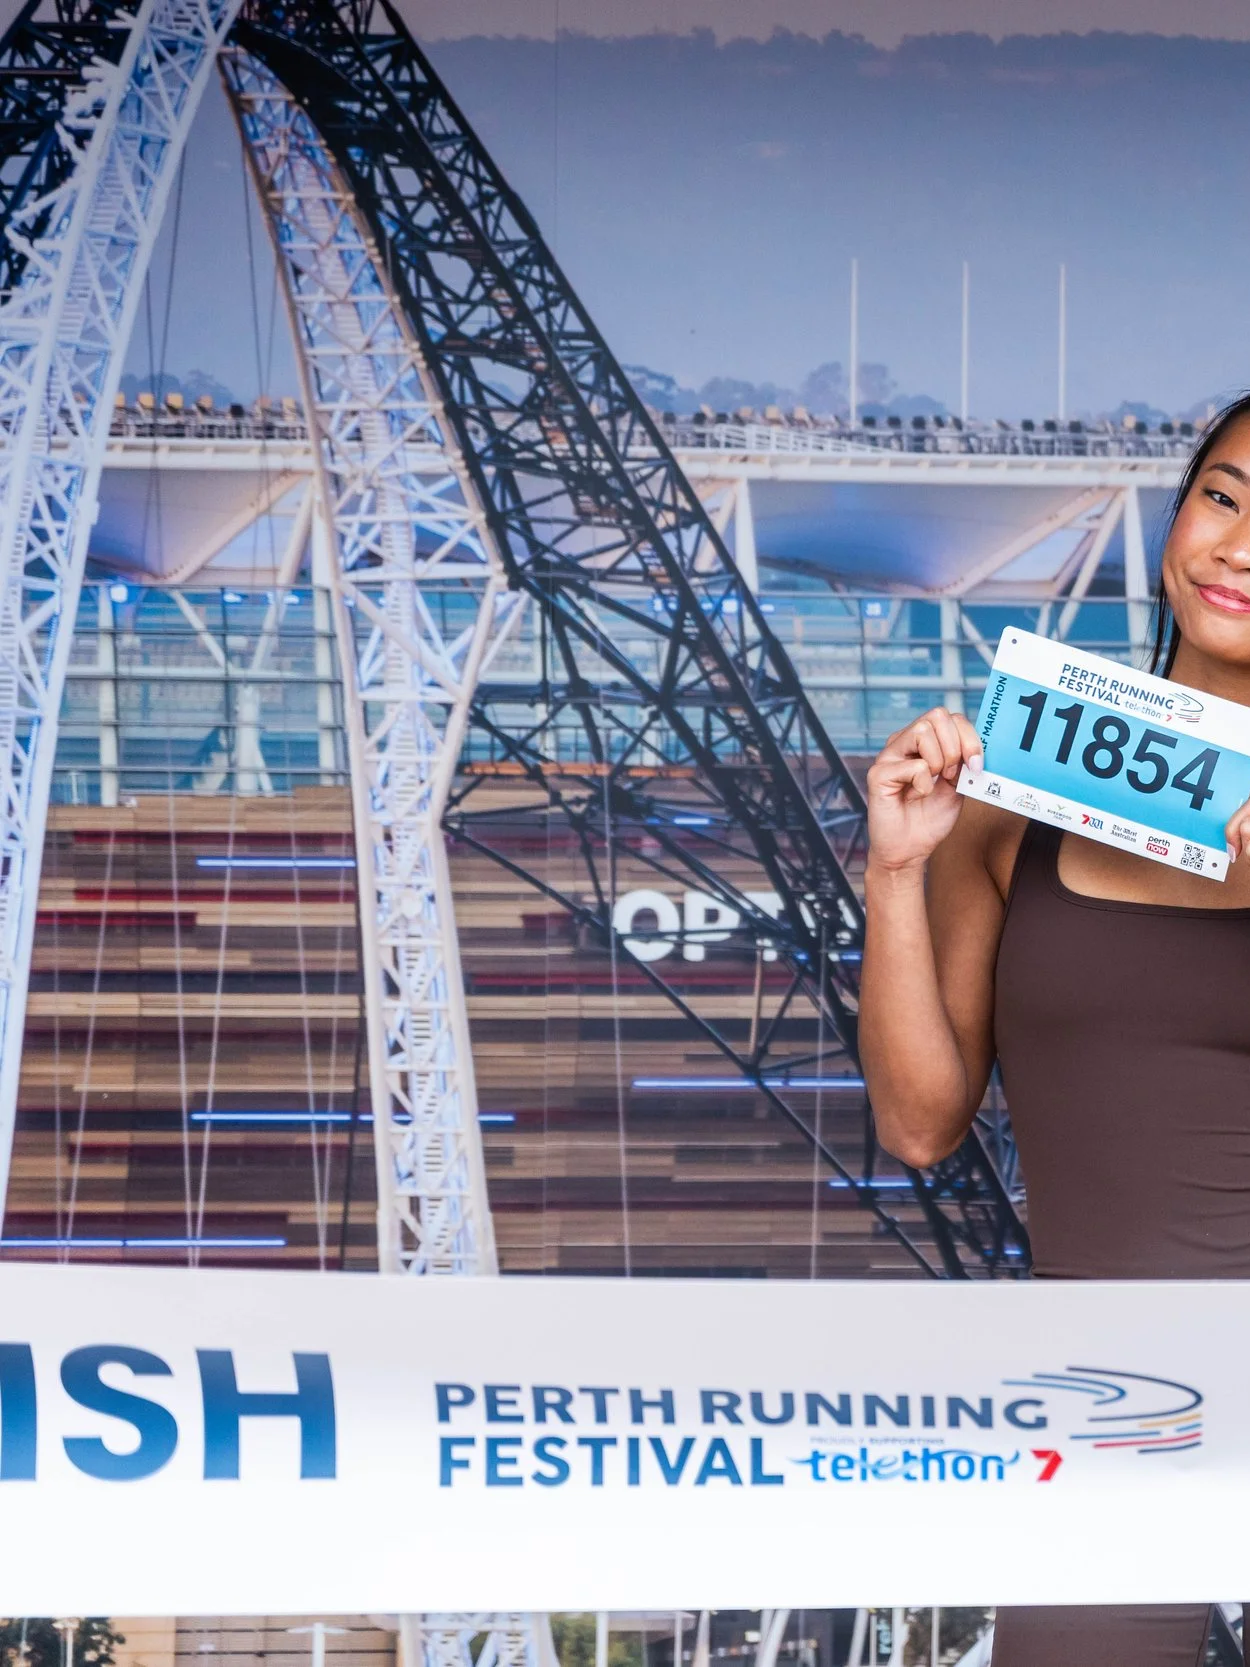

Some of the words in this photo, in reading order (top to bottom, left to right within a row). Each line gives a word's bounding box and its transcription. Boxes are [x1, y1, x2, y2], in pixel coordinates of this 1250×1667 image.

[982, 676, 1007, 737] MARATHON
[1058, 675, 1120, 706] FESTIVAL
[1062, 663, 1107, 687] PERTH
[1110, 679, 1175, 710] RUNNING
[1018, 690, 1221, 811] 11854
[1147, 843, 1168, 855] now
[1148, 835, 1171, 847] perth
[436, 1384, 675, 1425] PERTH
[701, 1388, 1048, 1430] RUNNING
[439, 1436, 785, 1487] FESTIVAL
[801, 1447, 1014, 1482] telethon
[1031, 1449, 1063, 1482] 7
